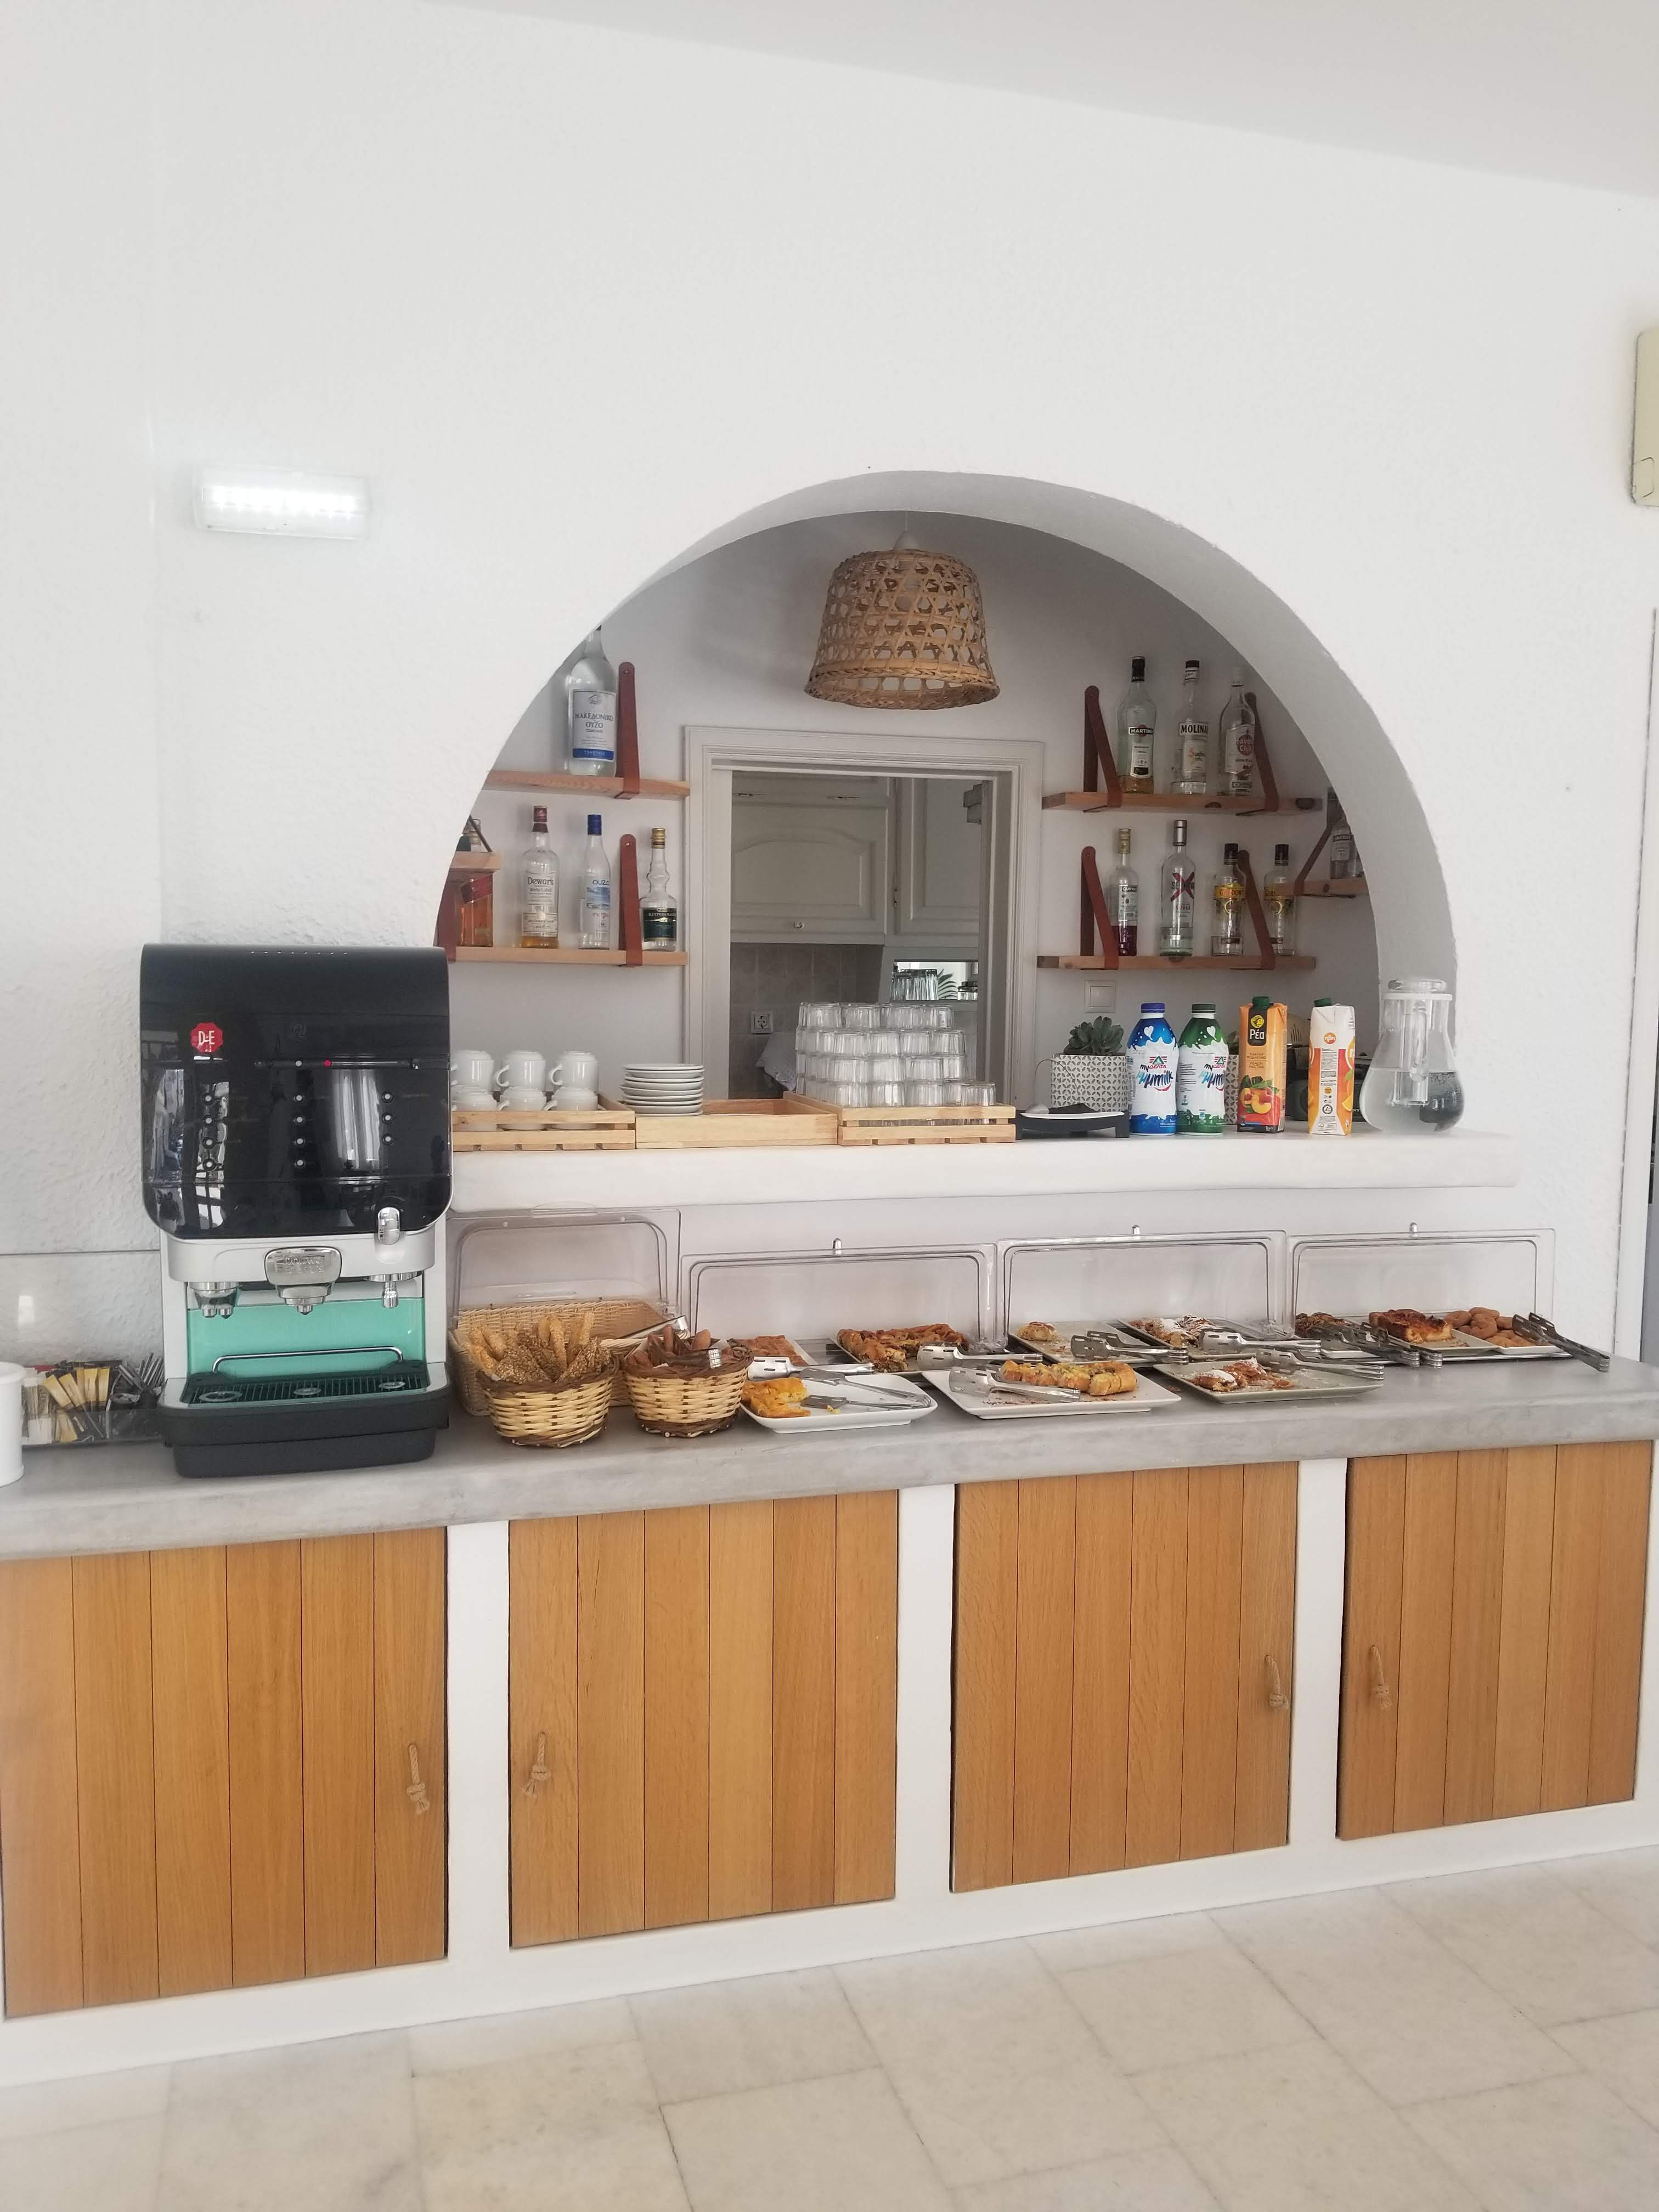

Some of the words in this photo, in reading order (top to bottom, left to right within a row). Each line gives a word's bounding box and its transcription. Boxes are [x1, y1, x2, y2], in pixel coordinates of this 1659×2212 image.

[1181, 724, 1207, 734] MOLINA
[527, 877, 554, 885] Dewar's
[1140, 1064, 1150, 1073] my
[1204, 1064, 1214, 1072] my
